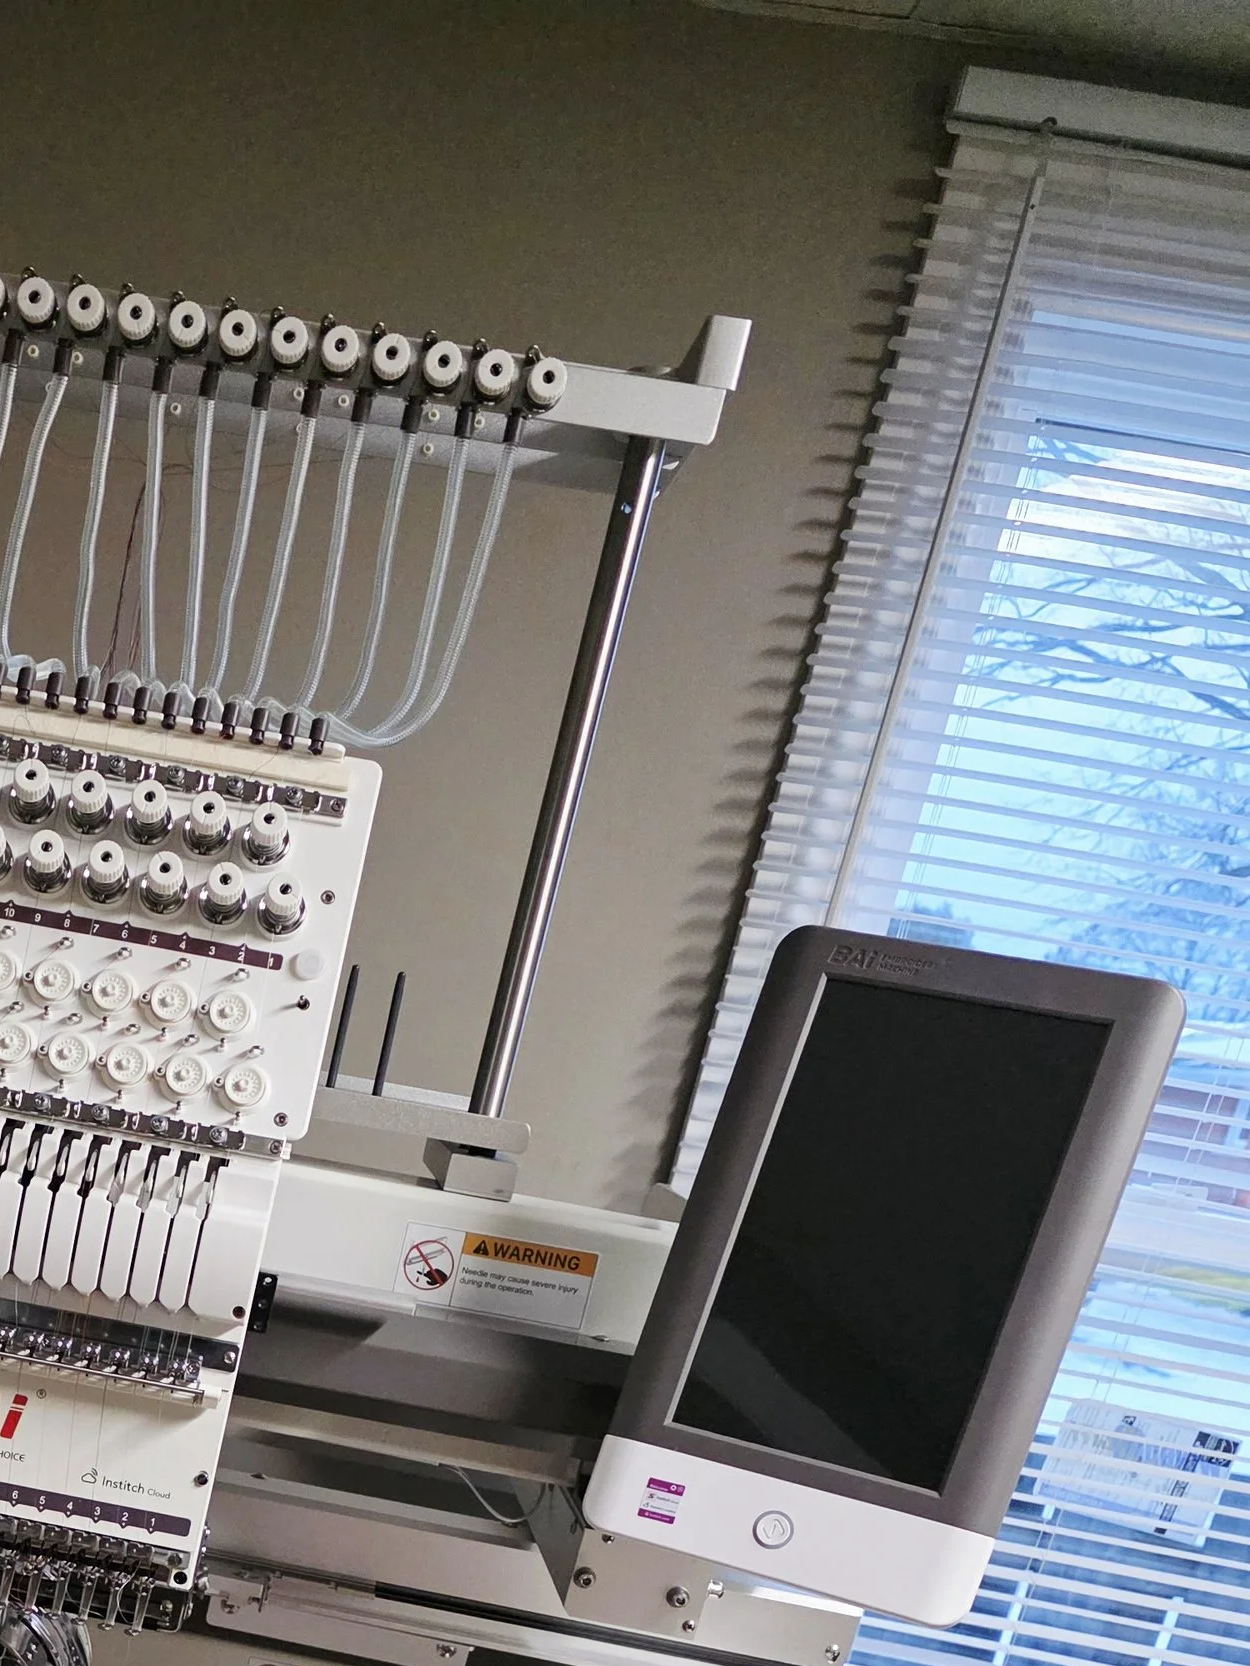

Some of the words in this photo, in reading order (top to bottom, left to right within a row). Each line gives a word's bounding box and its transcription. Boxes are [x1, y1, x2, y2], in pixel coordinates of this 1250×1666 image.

[4, 907, 16, 917] 10
[34, 913, 42, 922] 9
[63, 918, 71, 928] 8
[93, 924, 100, 933] 7
[121, 929, 129, 939] 6
[150, 935, 158, 944] 5
[179, 940, 186, 950] 4
[208, 946, 216, 955] 3
[237, 952, 245, 961] 2
[268, 957, 274, 967] 1
[493, 1242, 581, 1271] WARNING
[459, 1277, 483, 1288] during
[484, 1280, 496, 1290] the
[497, 1284, 534, 1296] operation.
[461, 1267, 488, 1279] Needle
[490, 1272, 506, 1282] may
[507, 1276, 530, 1286] cause
[531, 1280, 557, 1290] severe
[558, 1284, 579, 1295] injury
[101, 1476, 145, 1495] Institch
[147, 1487, 171, 1500] Cloud
[11, 1490, 19, 1500] 6
[39, 1496, 46, 1505] 5
[66, 1501, 73, 1510] 4
[94, 1506, 101, 1516] 3
[121, 1512, 129, 1521] 2
[150, 1517, 156, 1527] 1
